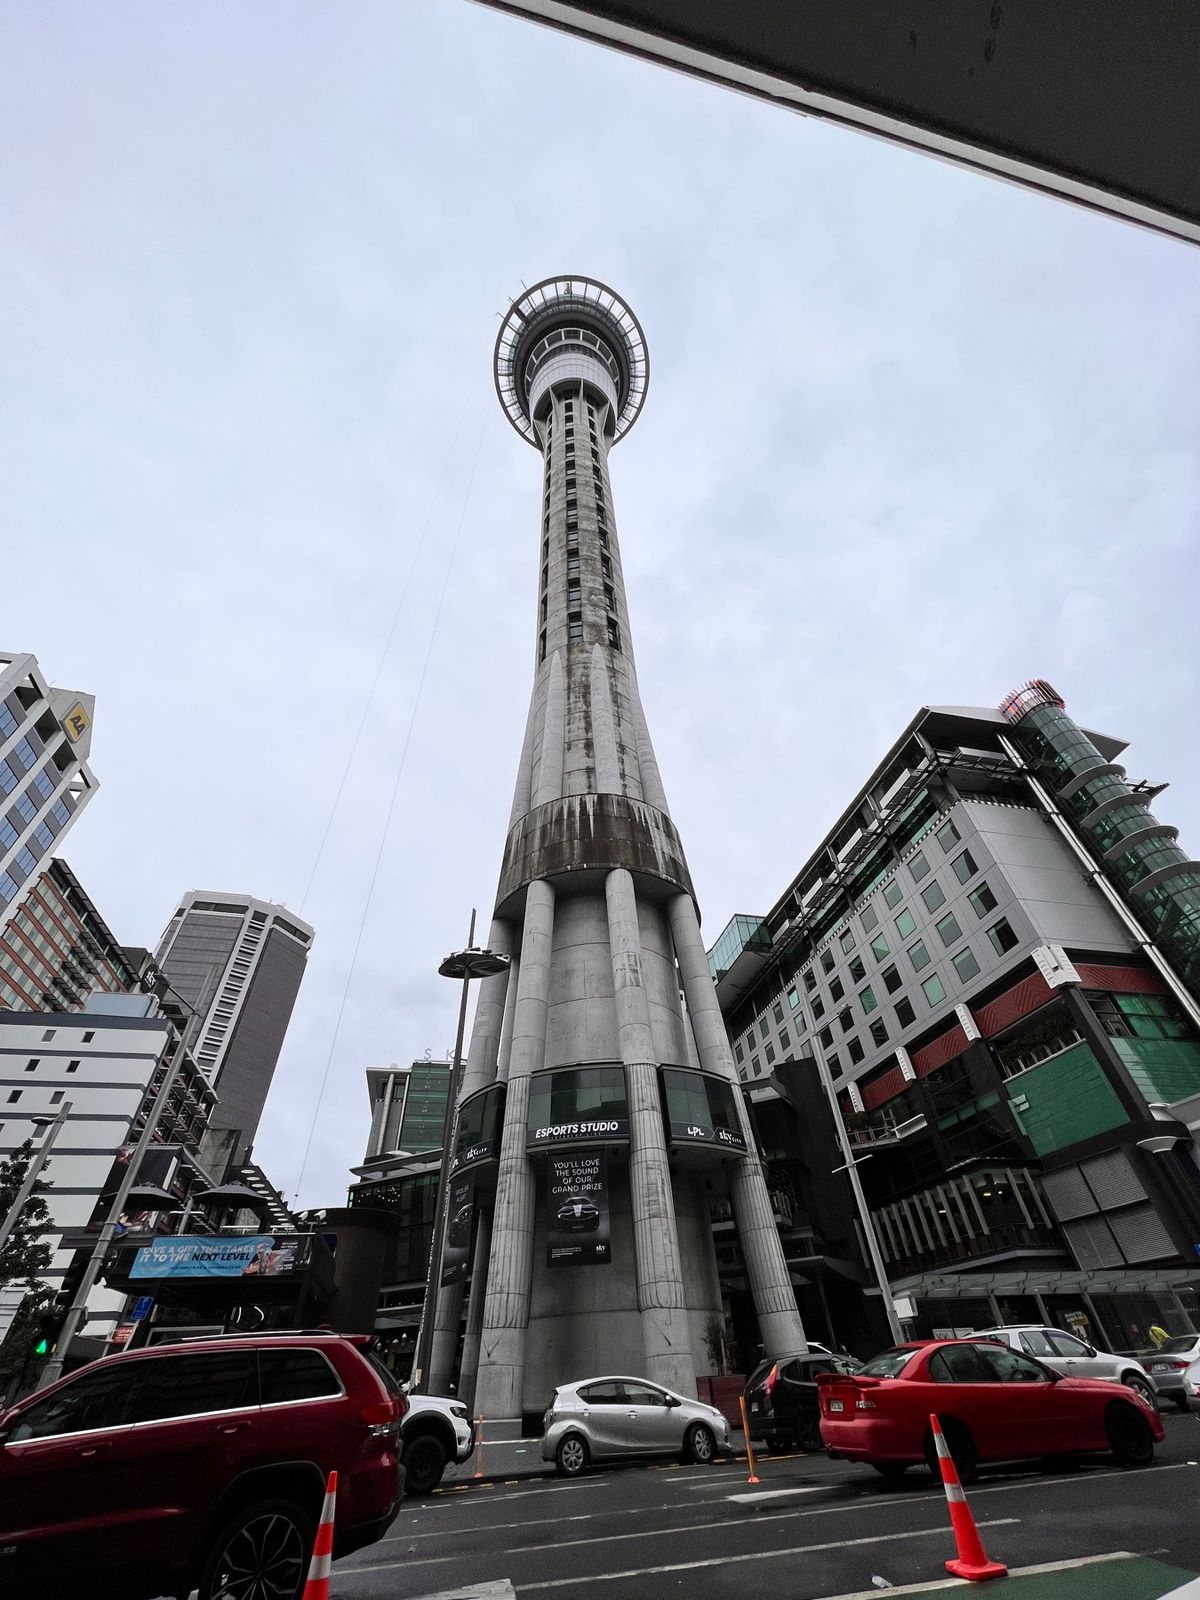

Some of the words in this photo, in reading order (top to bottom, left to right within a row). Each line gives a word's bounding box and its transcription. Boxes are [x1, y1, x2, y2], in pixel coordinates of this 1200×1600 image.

[70, 714, 86, 737] AA
[535, 1124, 579, 1138] ESPORTS
[580, 1121, 619, 1133] STUDIO
[687, 1126, 705, 1137] LPL
[553, 1161, 580, 1169] YOU'LL
[581, 1158, 600, 1167] LOVE
[556, 1169, 570, 1177] THE
[572, 1166, 599, 1176] SOUND
[562, 1177, 573, 1185] OF
[575, 1175, 592, 1184] OUR
[552, 1185, 579, 1194] GRAND
[581, 1182, 603, 1191] PRIZE
[143, 1246, 166, 1254] GIVE
[167, 1246, 175, 1254] A
[177, 1245, 200, 1254] GIFT
[201, 1245, 226, 1253] THAT
[226, 1245, 255, 1253] TAKES
[140, 1254, 152, 1263] IT
[153, 1254, 168, 1263] TO
[169, 1253, 191, 1262] THE
[191, 1252, 219, 1261] NEXT
[220, 1252, 251, 1261] LEVEL
